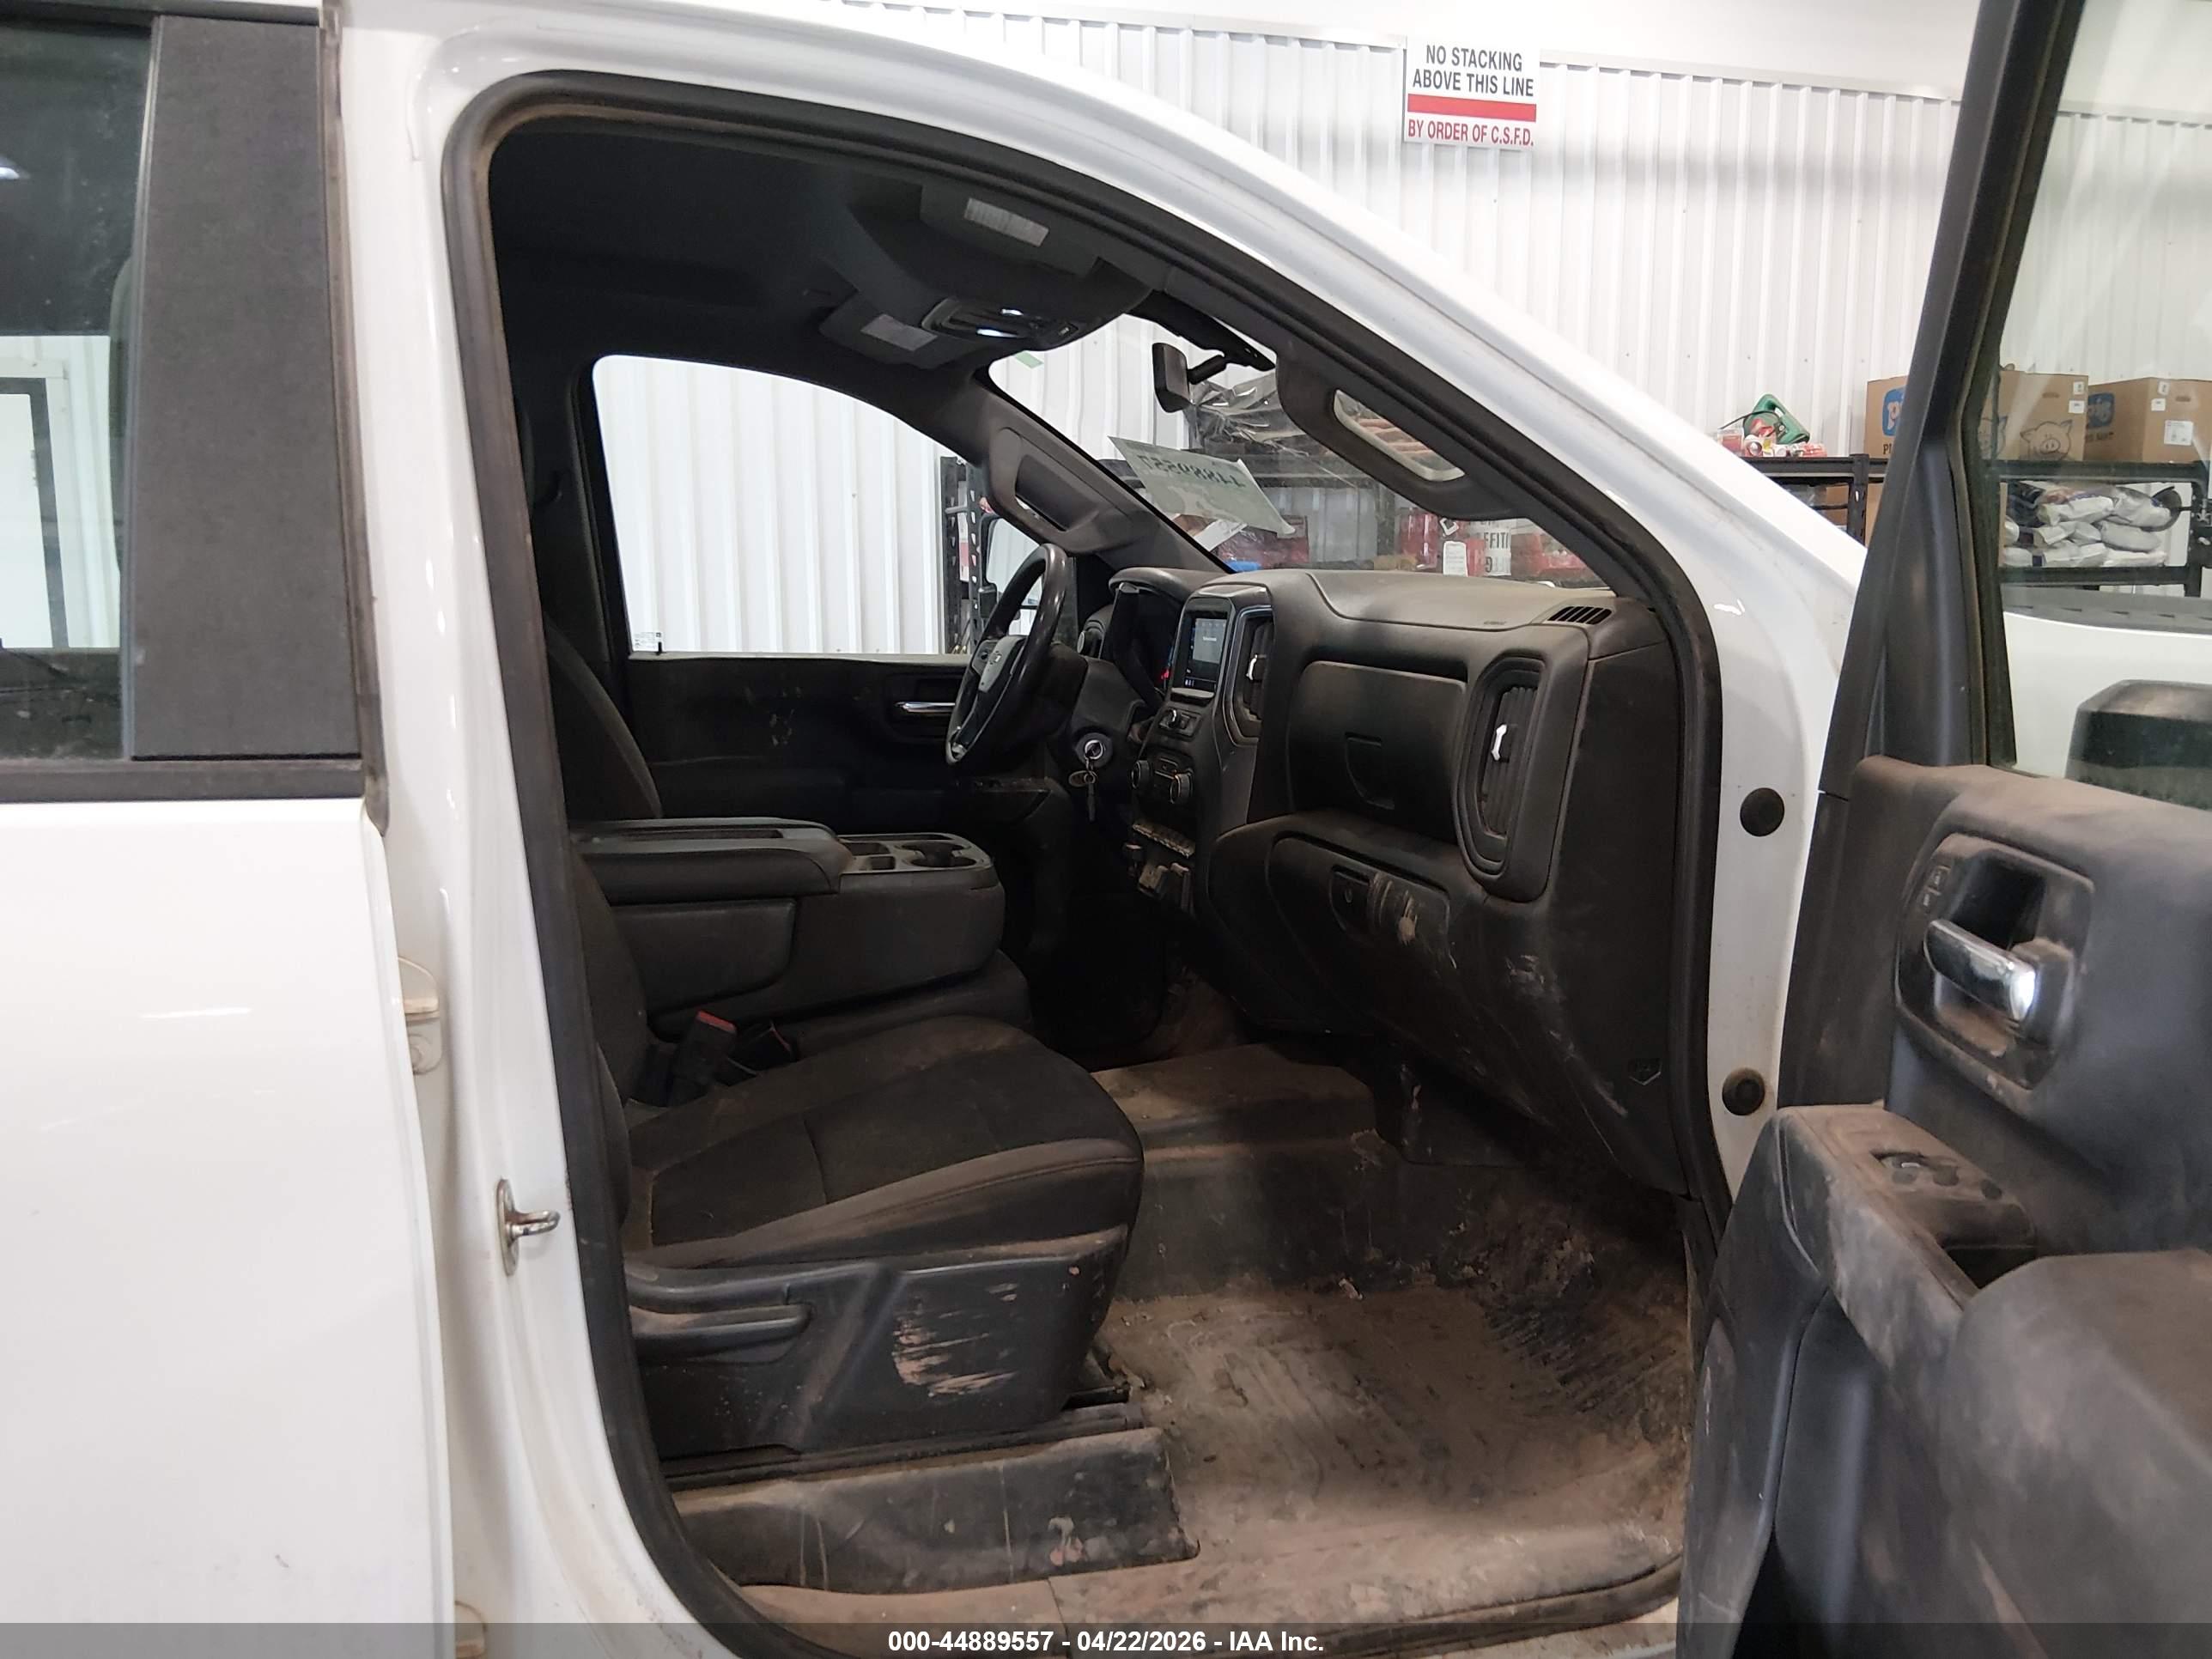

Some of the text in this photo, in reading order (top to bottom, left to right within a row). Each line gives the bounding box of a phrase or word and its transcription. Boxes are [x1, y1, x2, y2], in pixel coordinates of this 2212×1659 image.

[1426, 45, 1522, 71] NO STACKING
[1413, 69, 1534, 96] ABOVE THIS LINE
[1408, 119, 1534, 146] BY ORDER OF C.S.F.D.
